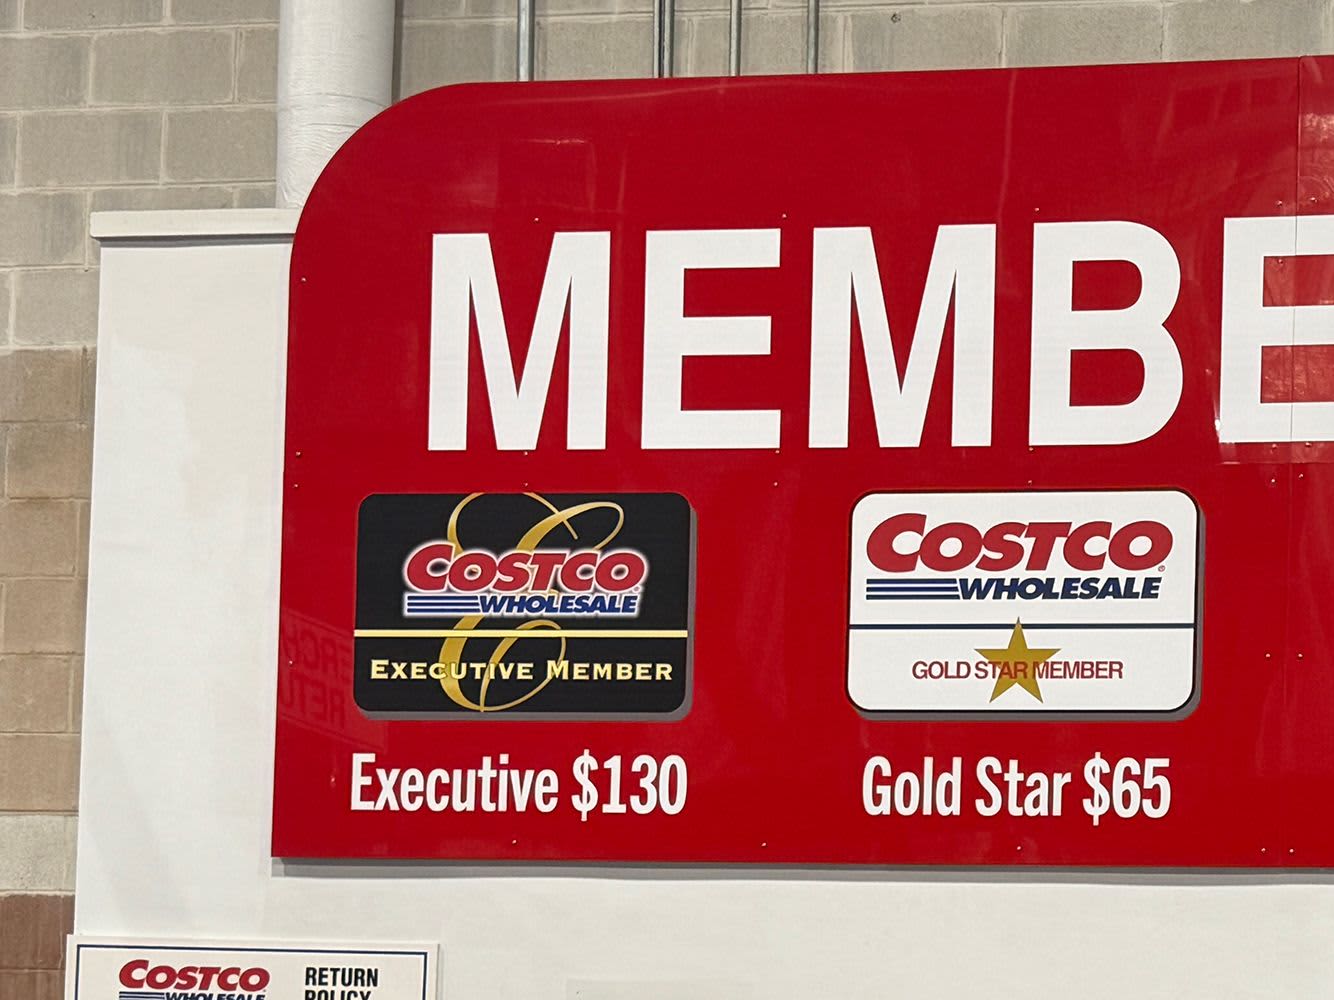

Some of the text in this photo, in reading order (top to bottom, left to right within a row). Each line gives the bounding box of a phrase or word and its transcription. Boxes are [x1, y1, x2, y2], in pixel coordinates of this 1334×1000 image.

[866, 512, 1174, 573] COSTCO
[406, 543, 646, 592] COSTCO
[479, 594, 638, 614] WHOLESALE
[958, 577, 1162, 600] WHOLESALE
[912, 660, 1124, 680] GOLD STAR MEMBER
[350, 749, 689, 822] Executive $130
[862, 751, 1172, 827] Gold Star $65
[118, 959, 271, 992] COSTCO
[304, 967, 379, 987] RETURN
